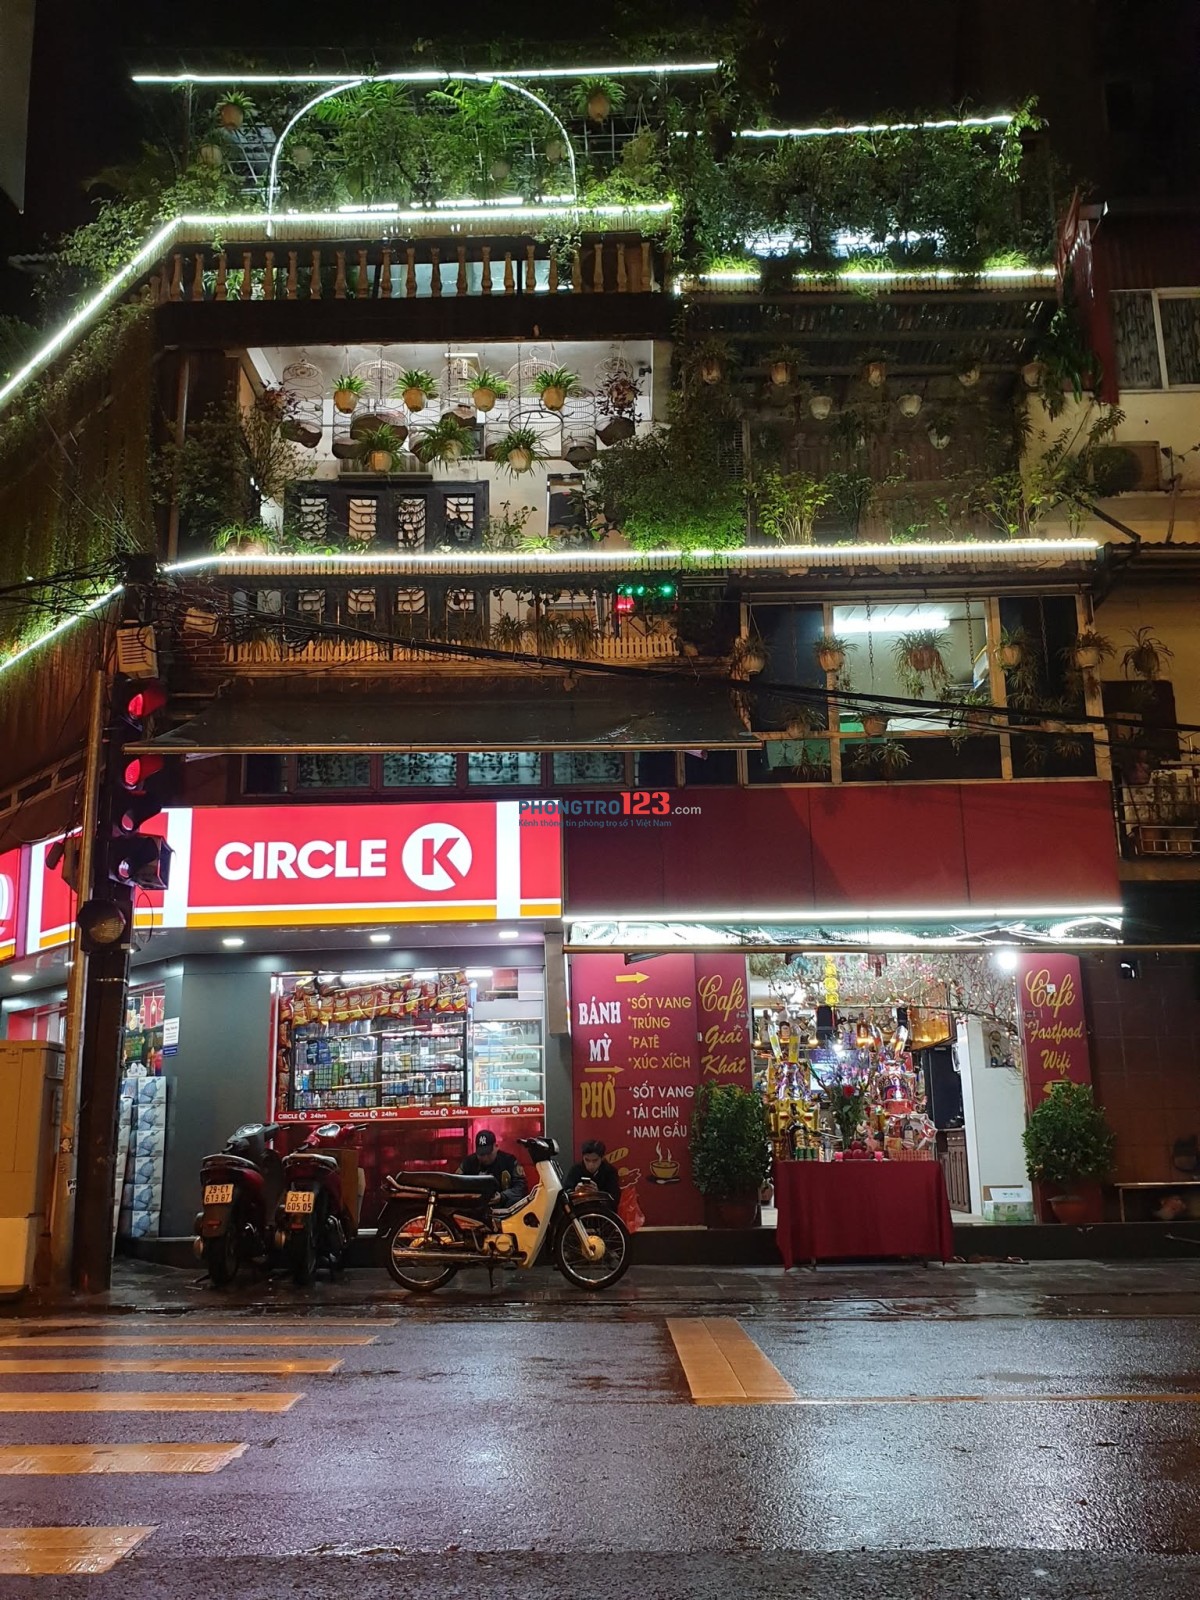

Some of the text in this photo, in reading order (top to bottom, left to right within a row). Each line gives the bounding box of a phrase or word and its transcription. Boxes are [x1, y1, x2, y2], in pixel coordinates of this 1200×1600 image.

[214, 839, 388, 881] CIRCLE
[631, 993, 692, 1009] SỐT VANG
[697, 974, 746, 1022] Café
[578, 995, 621, 1025] BÁNH
[632, 1012, 671, 1029] TRỨNG
[589, 1032, 612, 1062] MỲ
[633, 1033, 660, 1048] PATÊ
[633, 1052, 691, 1069] XÚC XÍCH
[701, 1054, 747, 1075] Khát
[1040, 1049, 1071, 1075] Wifi
[580, 1074, 616, 1118] PHỞ
[633, 1080, 695, 1098] SỐT VANG
[632, 1102, 679, 1118] TÁI CHÍN
[633, 1120, 687, 1138] NAM GẦU
